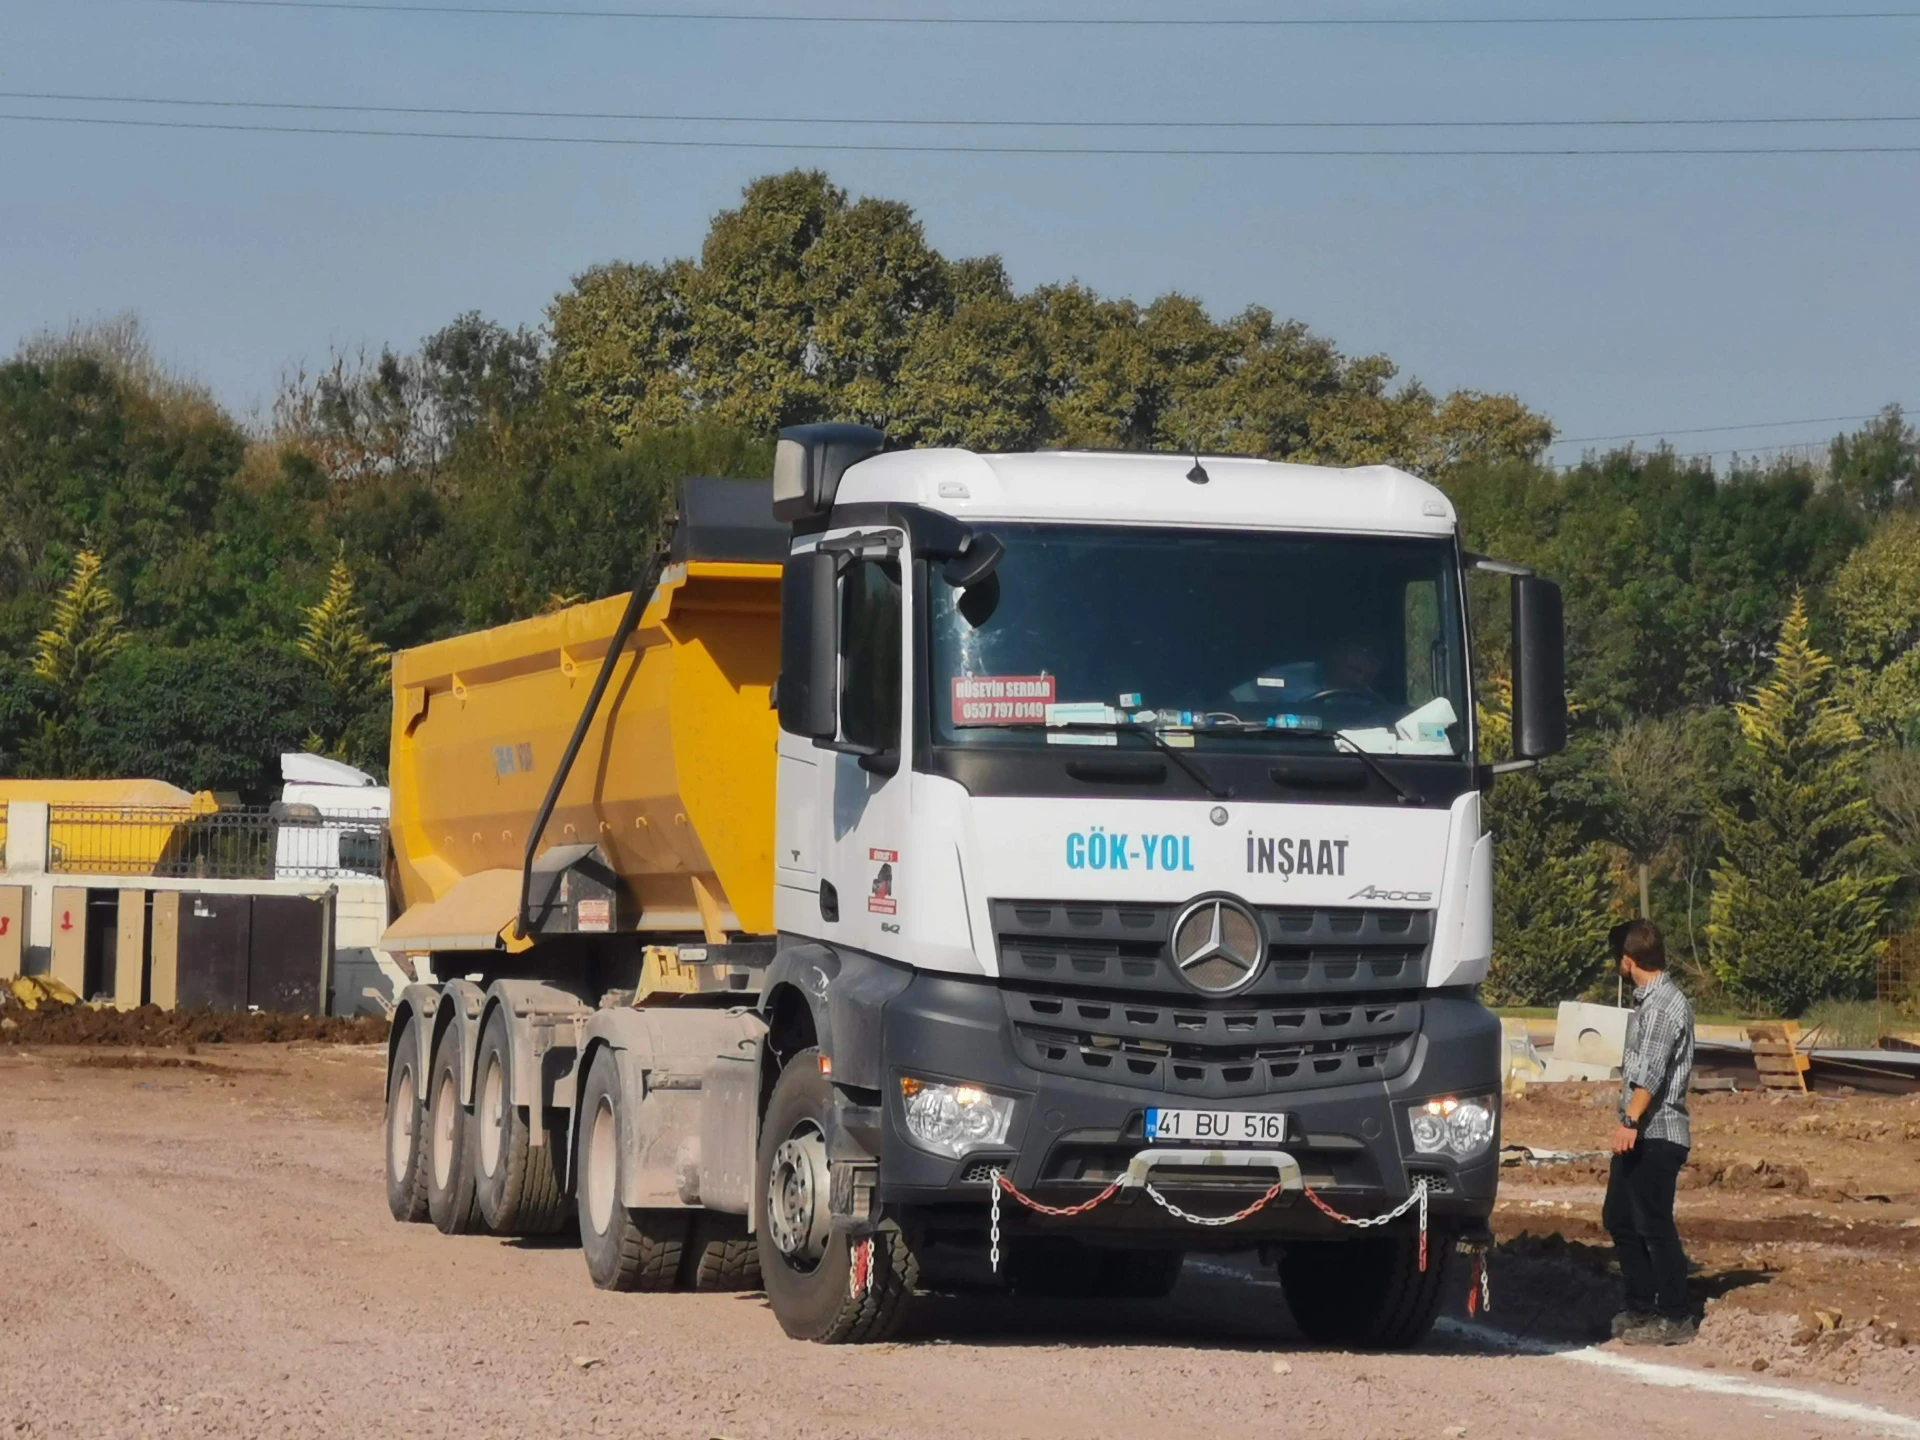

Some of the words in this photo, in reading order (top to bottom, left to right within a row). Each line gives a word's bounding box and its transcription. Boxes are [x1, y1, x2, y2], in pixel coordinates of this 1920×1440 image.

[1006, 682, 1050, 697] SERDAR
[963, 702, 992, 718] 0537
[1066, 826, 1194, 871] GÖK-YOL
[1247, 830, 1349, 883] İNŞAAT
[1159, 1112, 1180, 1135] 41
[1196, 1113, 1229, 1136] BU
[1245, 1115, 1279, 1138] 516
